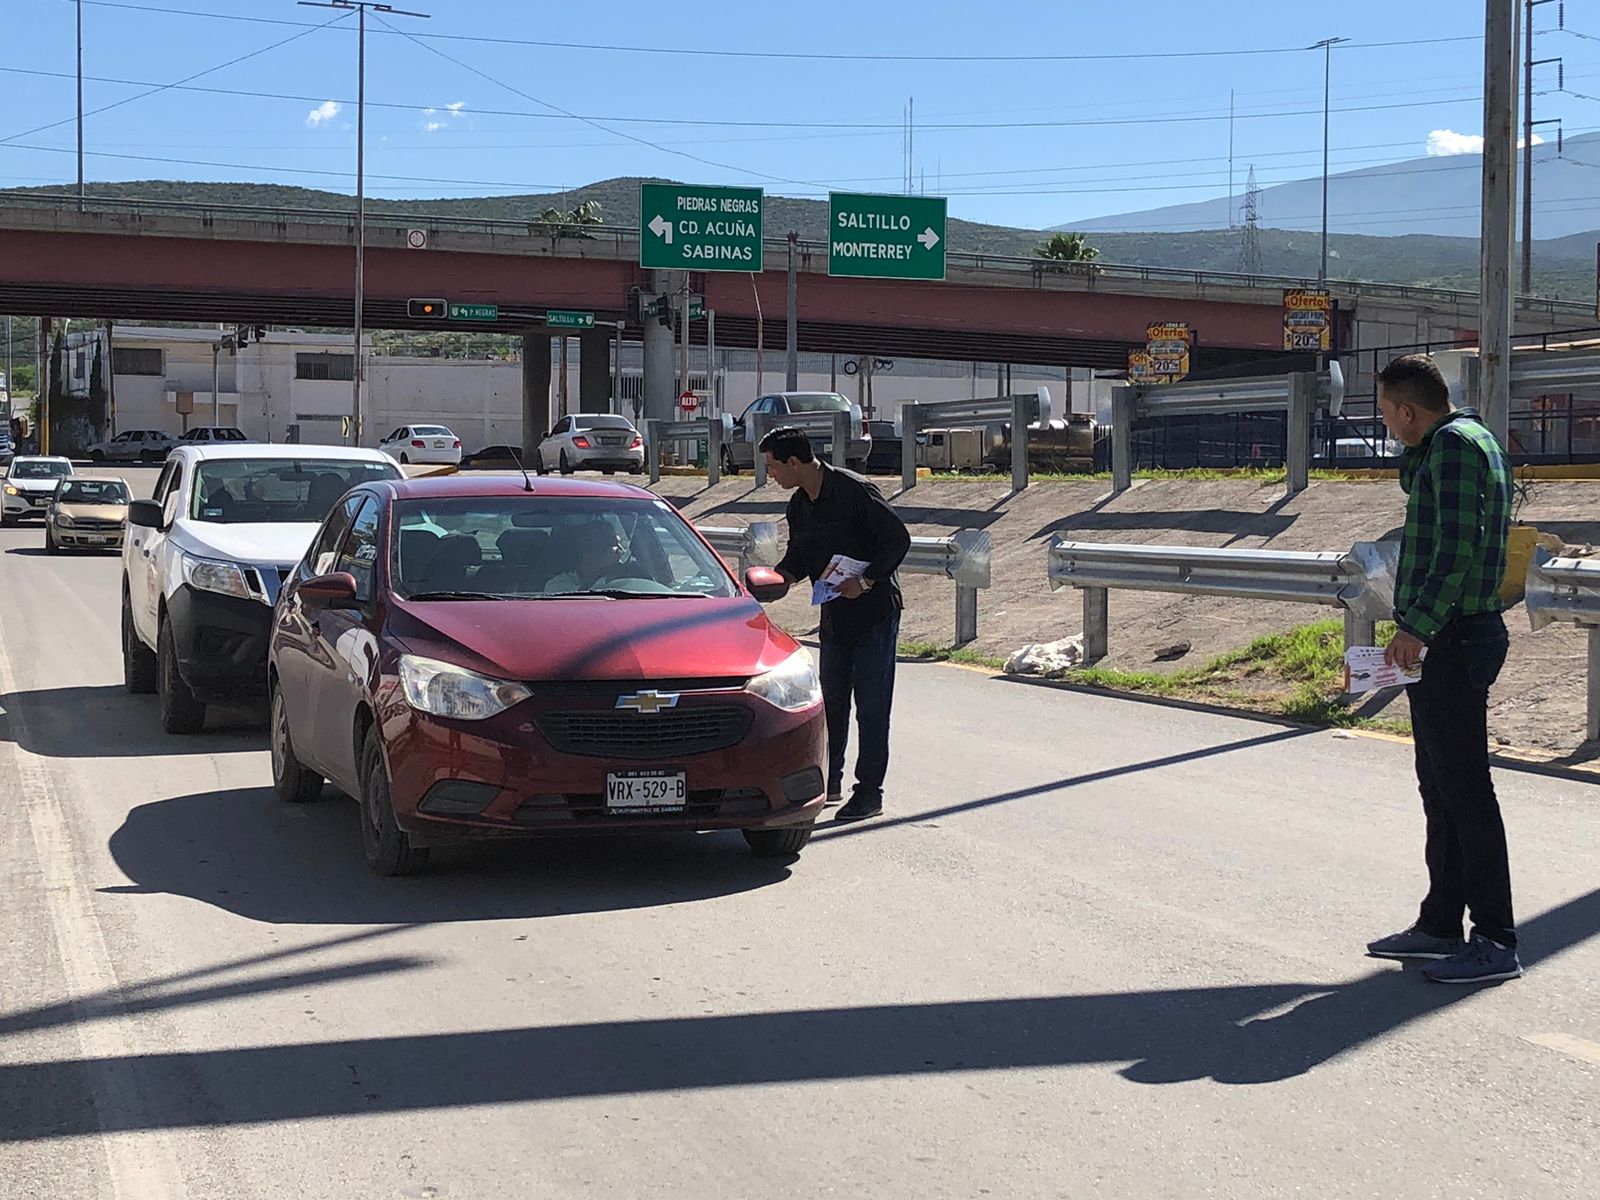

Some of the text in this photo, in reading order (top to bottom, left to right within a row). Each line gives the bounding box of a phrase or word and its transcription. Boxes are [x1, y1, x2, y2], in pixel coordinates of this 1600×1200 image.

[677, 196, 759, 213] PIEDRAS NEGRAS
[678, 219, 756, 238] CD. ACUÑA
[837, 211, 911, 231] SALTILLO
[682, 244, 753, 261] SABINAS
[832, 241, 913, 260] MONTERREY
[548, 315, 575, 324] SALTILLO
[681, 396, 698, 406] ALTO
[608, 779, 685, 801] VRX-529-B
